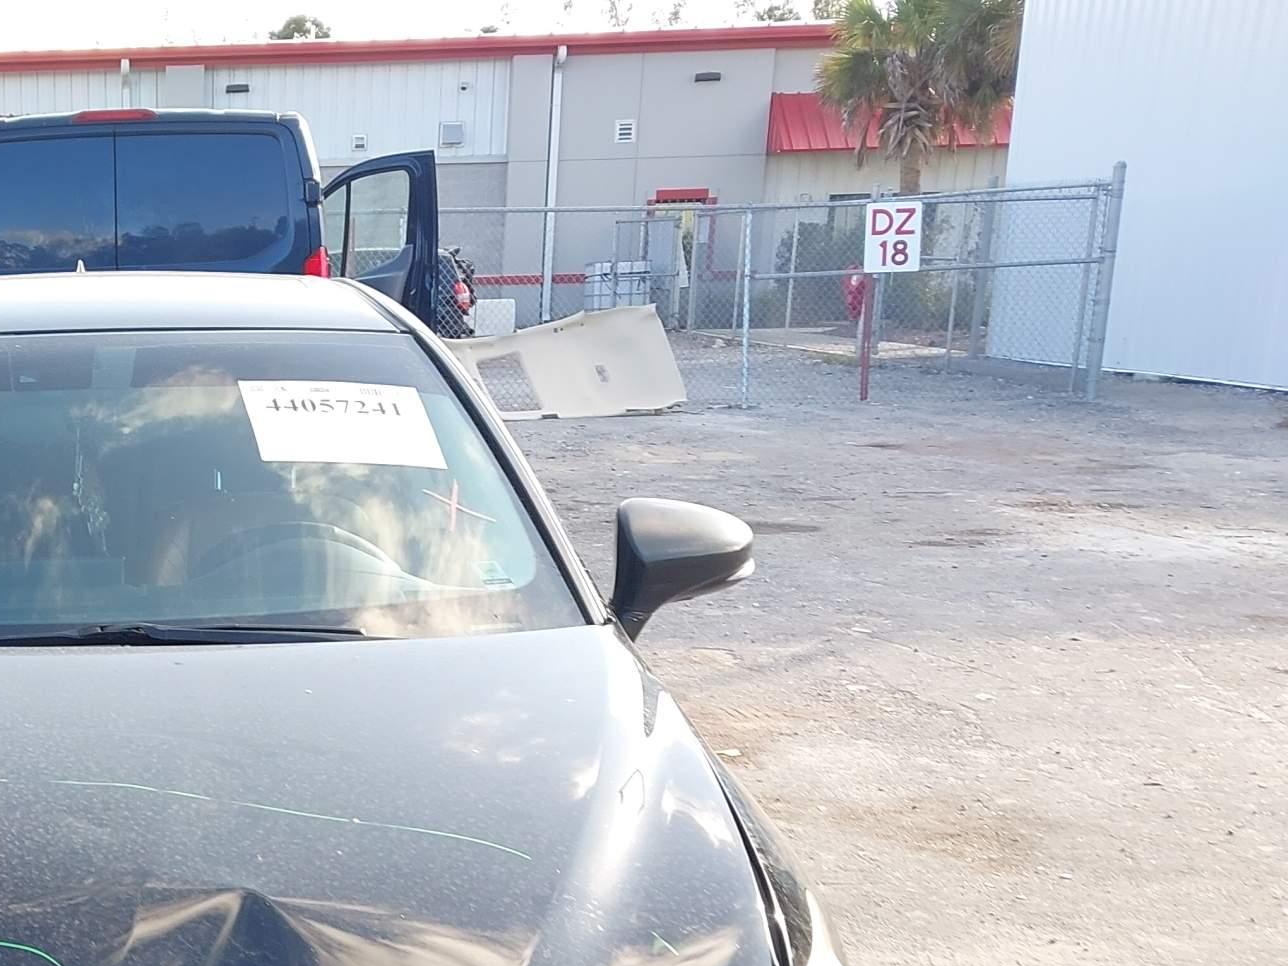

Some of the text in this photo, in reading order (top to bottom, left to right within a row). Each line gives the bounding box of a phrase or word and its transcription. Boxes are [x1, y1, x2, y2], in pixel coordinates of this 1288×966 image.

[872, 208, 916, 235] DZ
[879, 240, 908, 266] 18
[266, 398, 401, 416] 44057241
